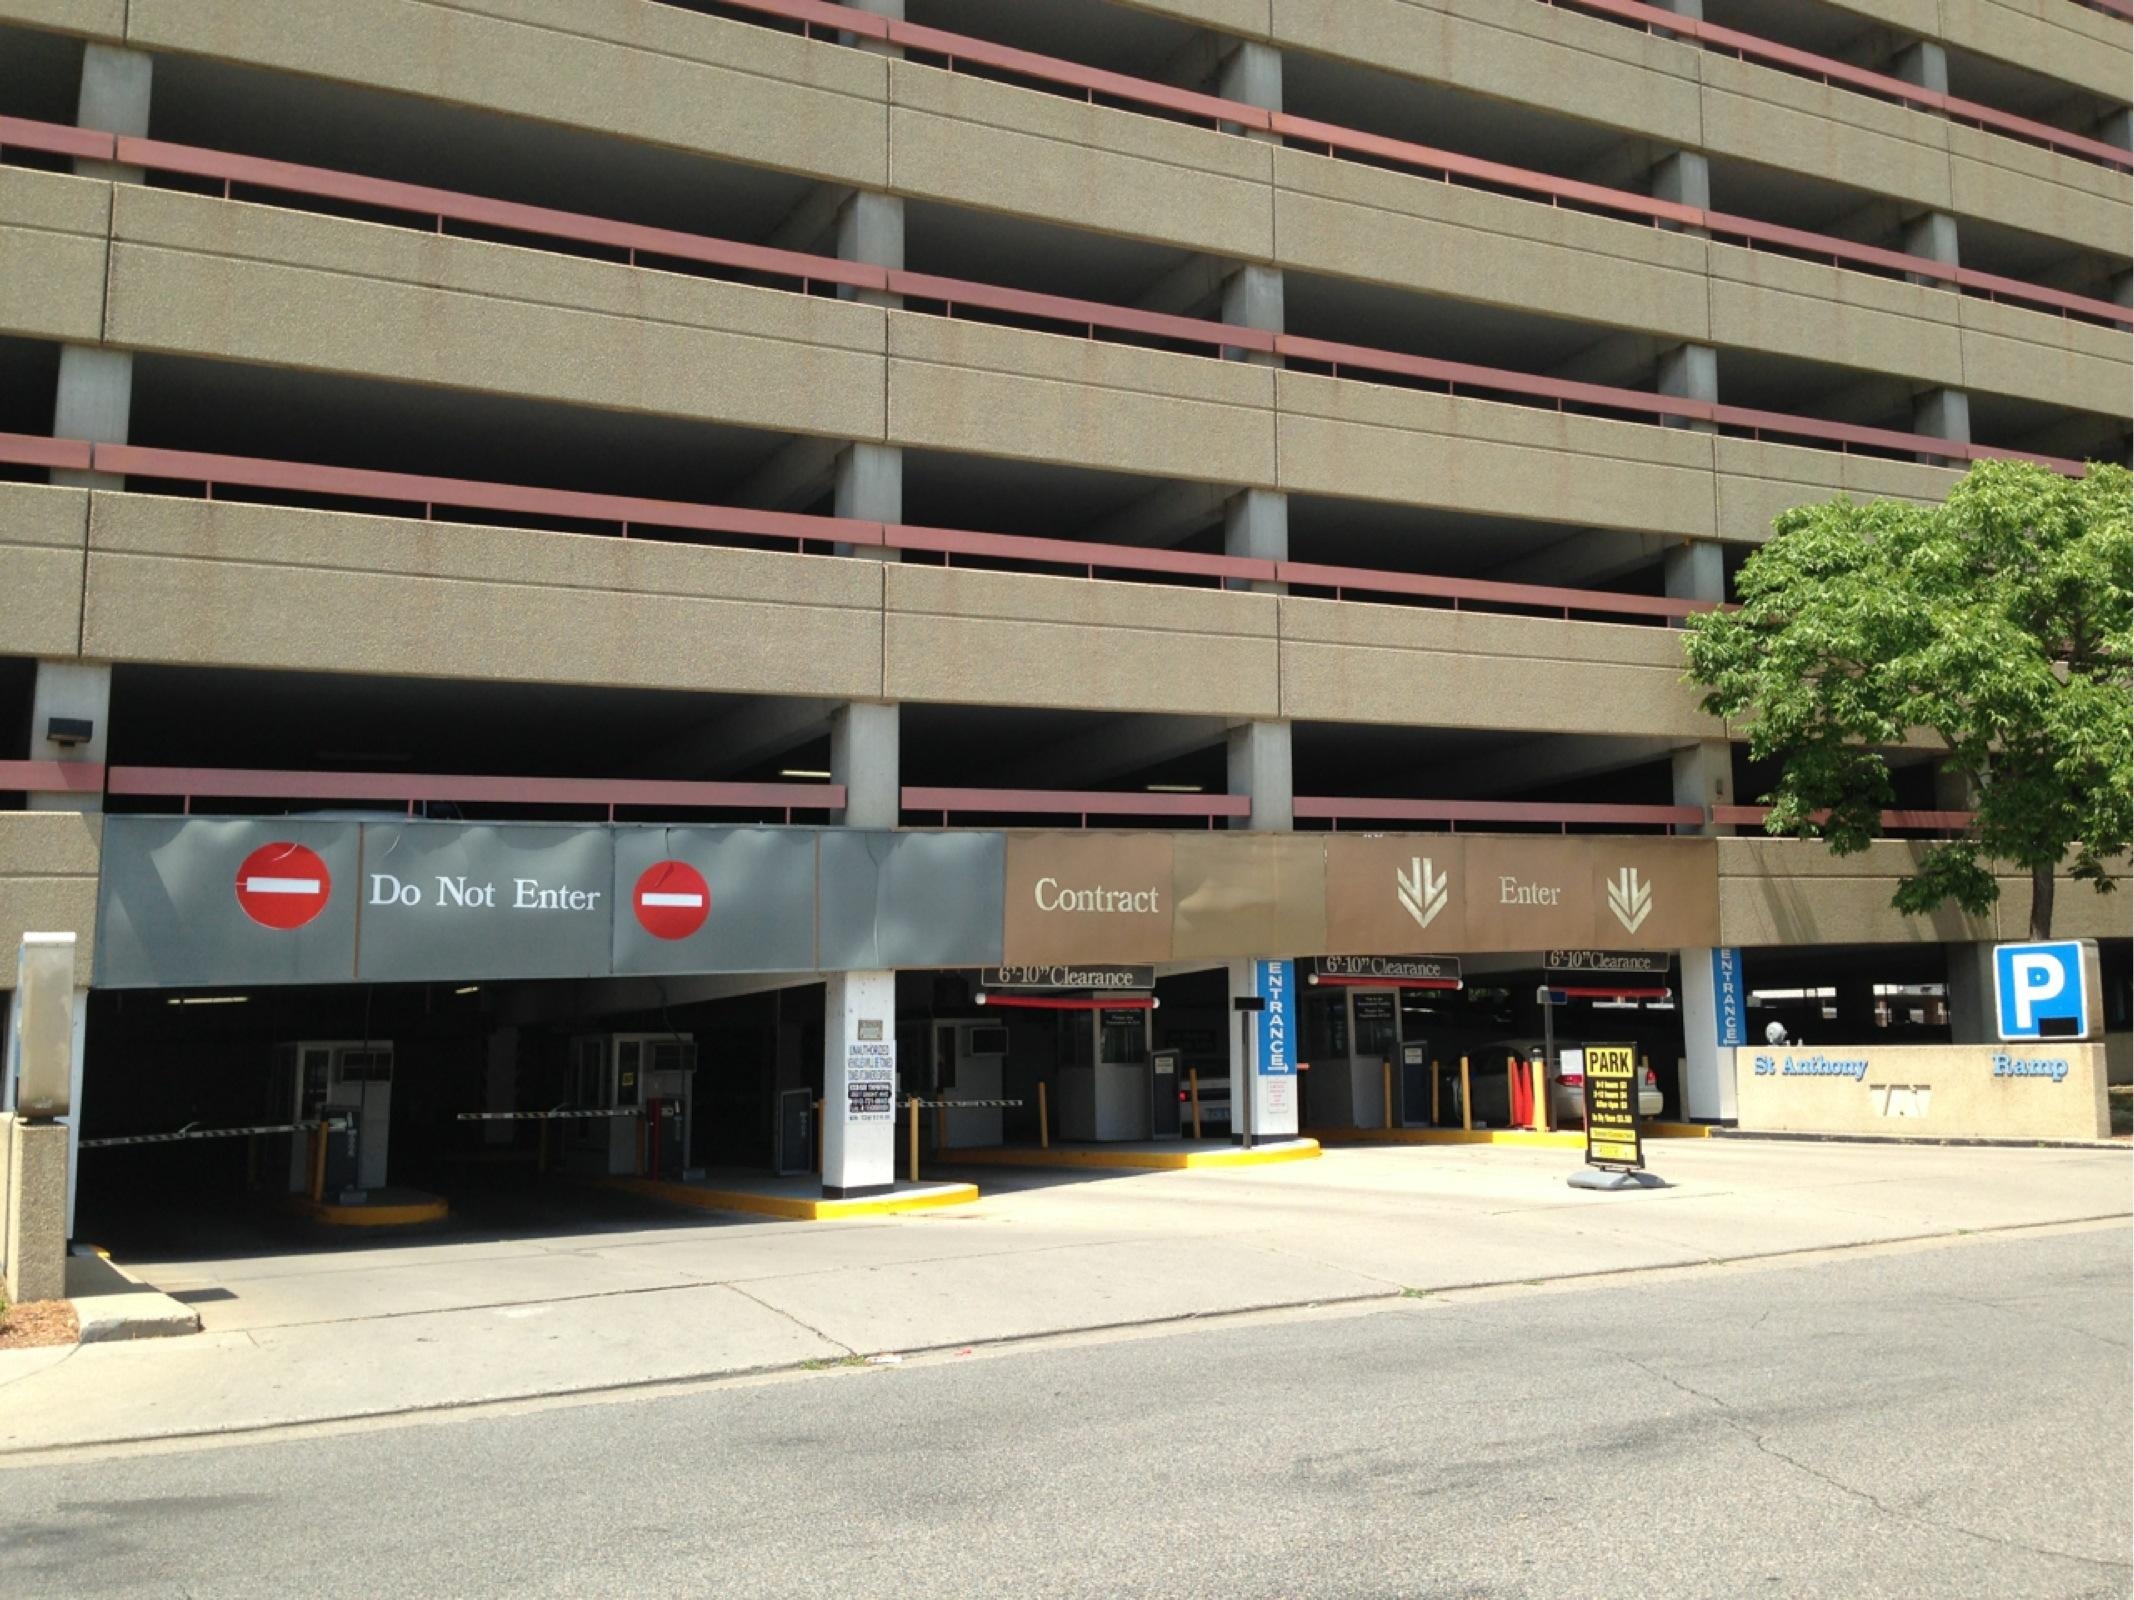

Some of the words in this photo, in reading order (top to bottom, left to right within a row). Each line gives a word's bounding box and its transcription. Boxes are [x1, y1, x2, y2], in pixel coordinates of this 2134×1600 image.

[369, 873, 421, 906] Do
[435, 875, 496, 908] Not
[512, 877, 601, 911] Enter
[1034, 877, 1159, 913] Contract
[1498, 875, 1561, 906] Enter
[1051, 966, 1134, 986] Clearance
[1371, 957, 1441, 977] Clearance
[1590, 951, 1651, 970] Clearance
[1721, 948, 1737, 1040] ENTRANCE
[2012, 953, 2066, 1029] P
[1268, 962, 1284, 1067] ENTRANCE
[1589, 1051, 1629, 1073] PARK
[1755, 1055, 1776, 1076] St
[1782, 1055, 1869, 1083] Anthony
[1993, 1053, 2069, 1083] Ramp
